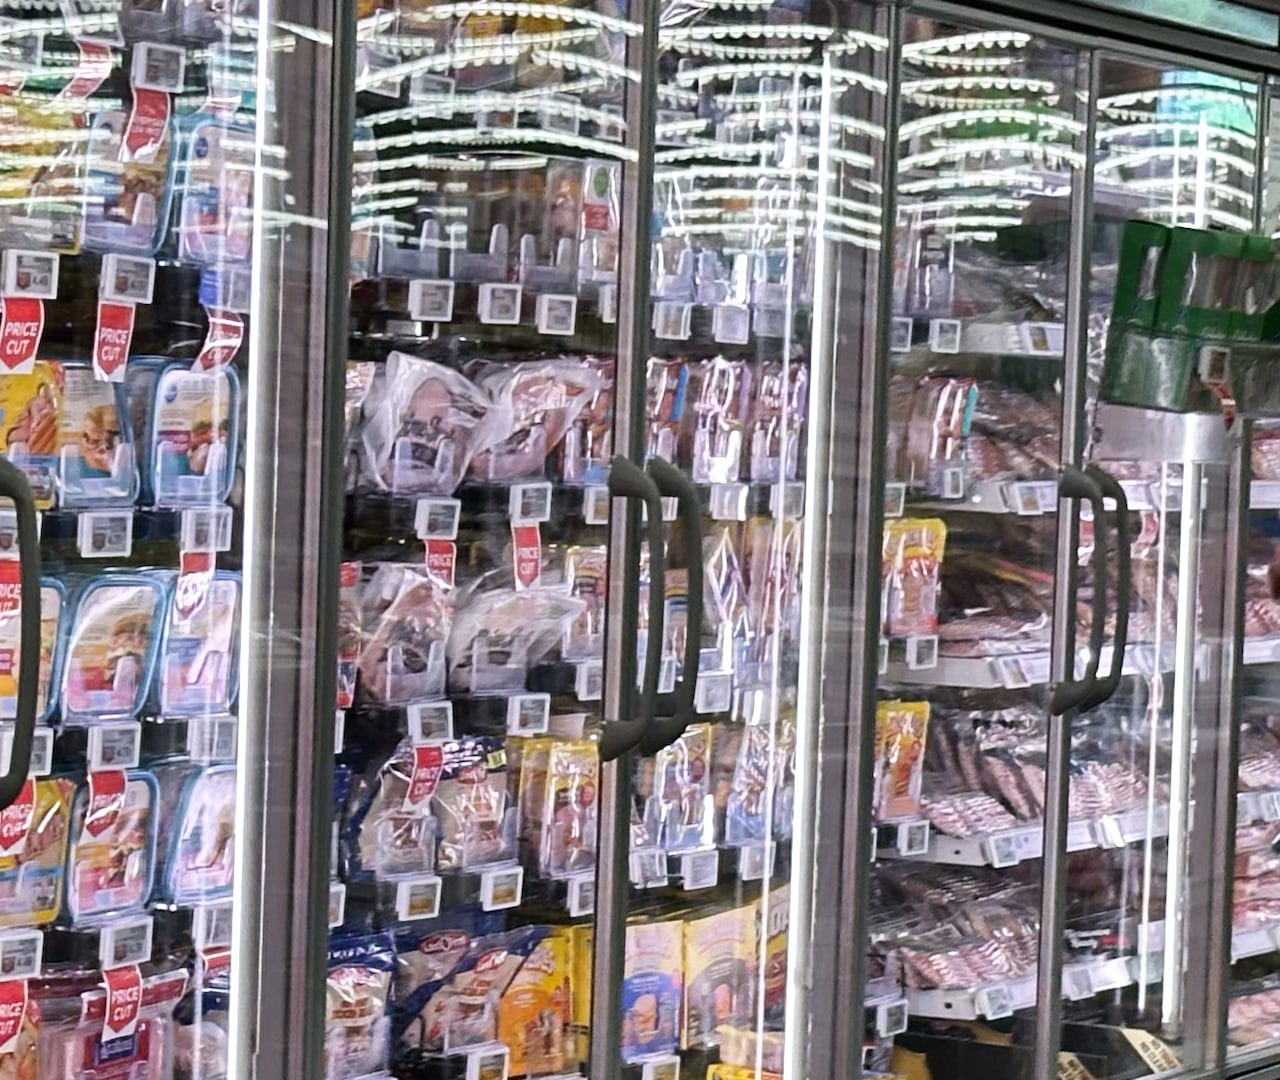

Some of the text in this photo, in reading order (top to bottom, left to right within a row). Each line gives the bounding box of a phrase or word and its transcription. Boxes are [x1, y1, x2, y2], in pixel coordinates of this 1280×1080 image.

[4, 320, 39, 337] PRICE
[99, 327, 127, 344] PRICE
[5, 339, 30, 355] CUT
[100, 345, 119, 362] CUT
[110, 986, 139, 1004] PRICE
[112, 1005, 132, 1022] CUT
